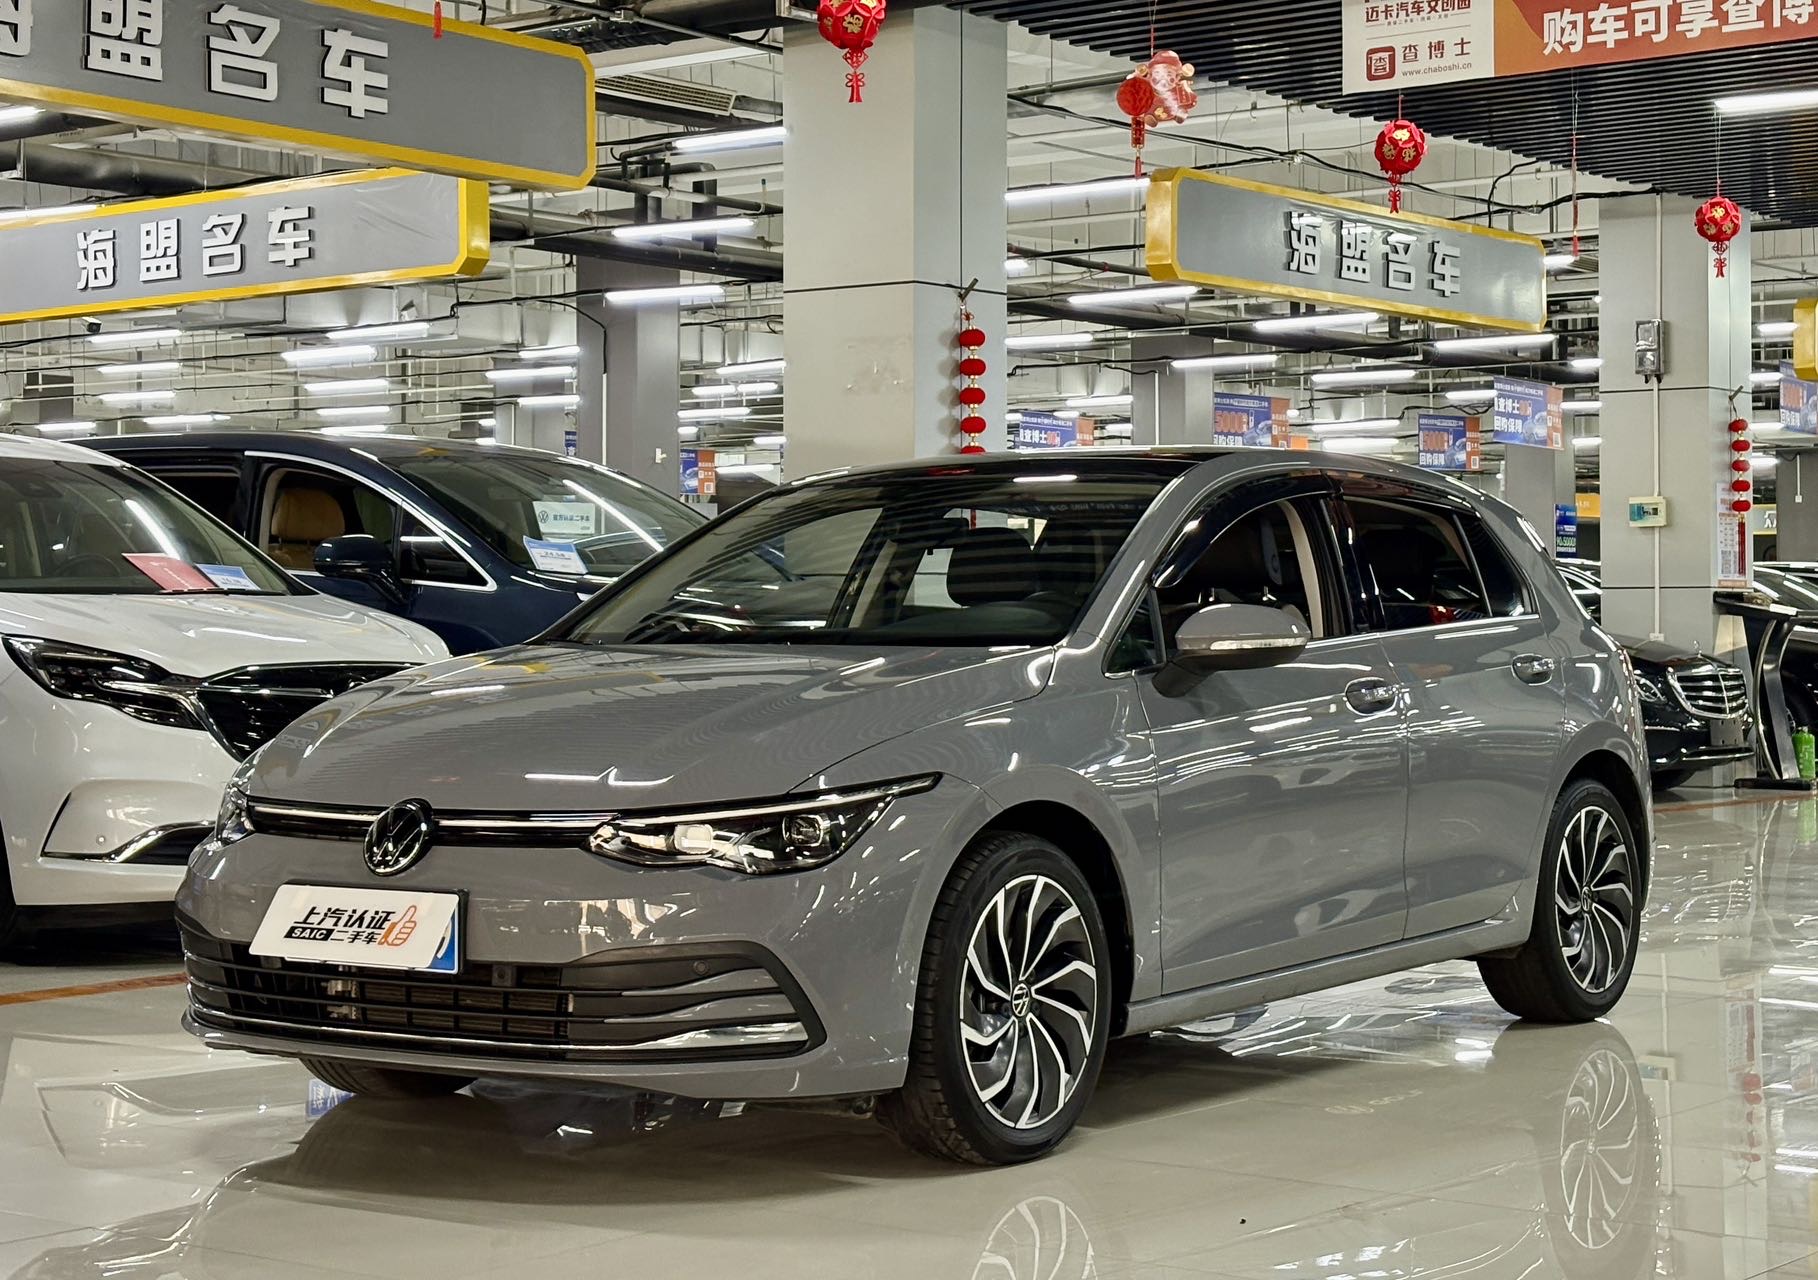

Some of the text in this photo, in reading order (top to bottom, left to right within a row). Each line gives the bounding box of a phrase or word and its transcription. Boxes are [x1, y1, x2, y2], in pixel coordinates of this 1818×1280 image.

[1402, 37, 1471, 63] 查博士
[1401, 62, 1472, 77] www.chaboshi.cn
[76, 206, 313, 290] 海盟名车
[1286, 210, 1461, 297] 海盟名车
[294, 905, 397, 930] 上汽认证
[292, 927, 382, 945] SAIC 二手车
